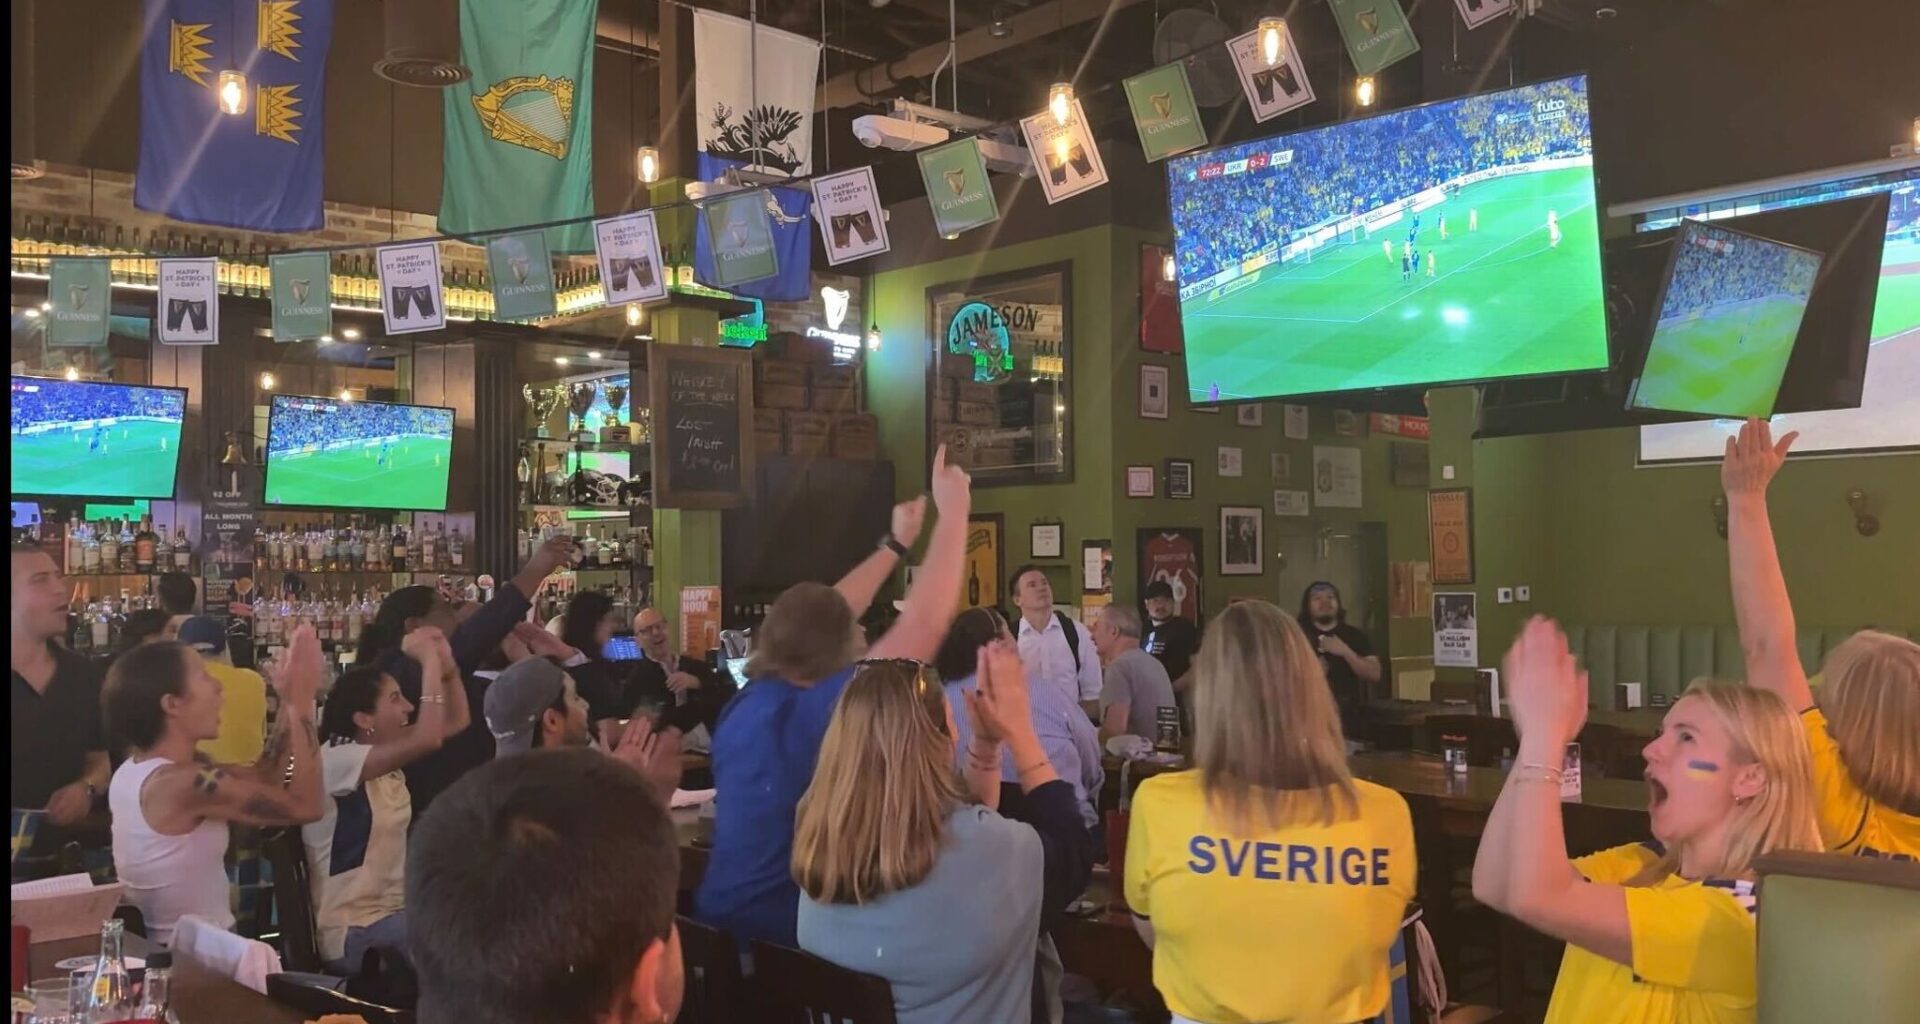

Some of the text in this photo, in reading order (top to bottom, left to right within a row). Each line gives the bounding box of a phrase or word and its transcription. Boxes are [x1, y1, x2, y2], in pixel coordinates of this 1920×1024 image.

[1356, 26, 1401, 52] GUINNESS
[1537, 99, 1565, 112] fubo
[1147, 115, 1190, 135] GUINNESS
[1201, 152, 1289, 177] 72:22 UKR 0-2 SWE
[831, 181, 854, 191] HAPPY
[833, 184, 868, 198] PATRICK'S
[839, 195, 852, 203] DAY
[941, 191, 985, 211] GUINNESS
[612, 226, 636, 234] HAPPY
[397, 260, 432, 269] PATRICK'S
[502, 284, 545, 297] GUINNESS
[57, 311, 99, 322] GUINNESS
[281, 305, 323, 317] GUINNESS
[953, 305, 1039, 345] JAMESON
[682, 589, 712, 600] HAPPY
[682, 601, 708, 613] HOUR
[1188, 835, 1390, 886] SVERIGE
